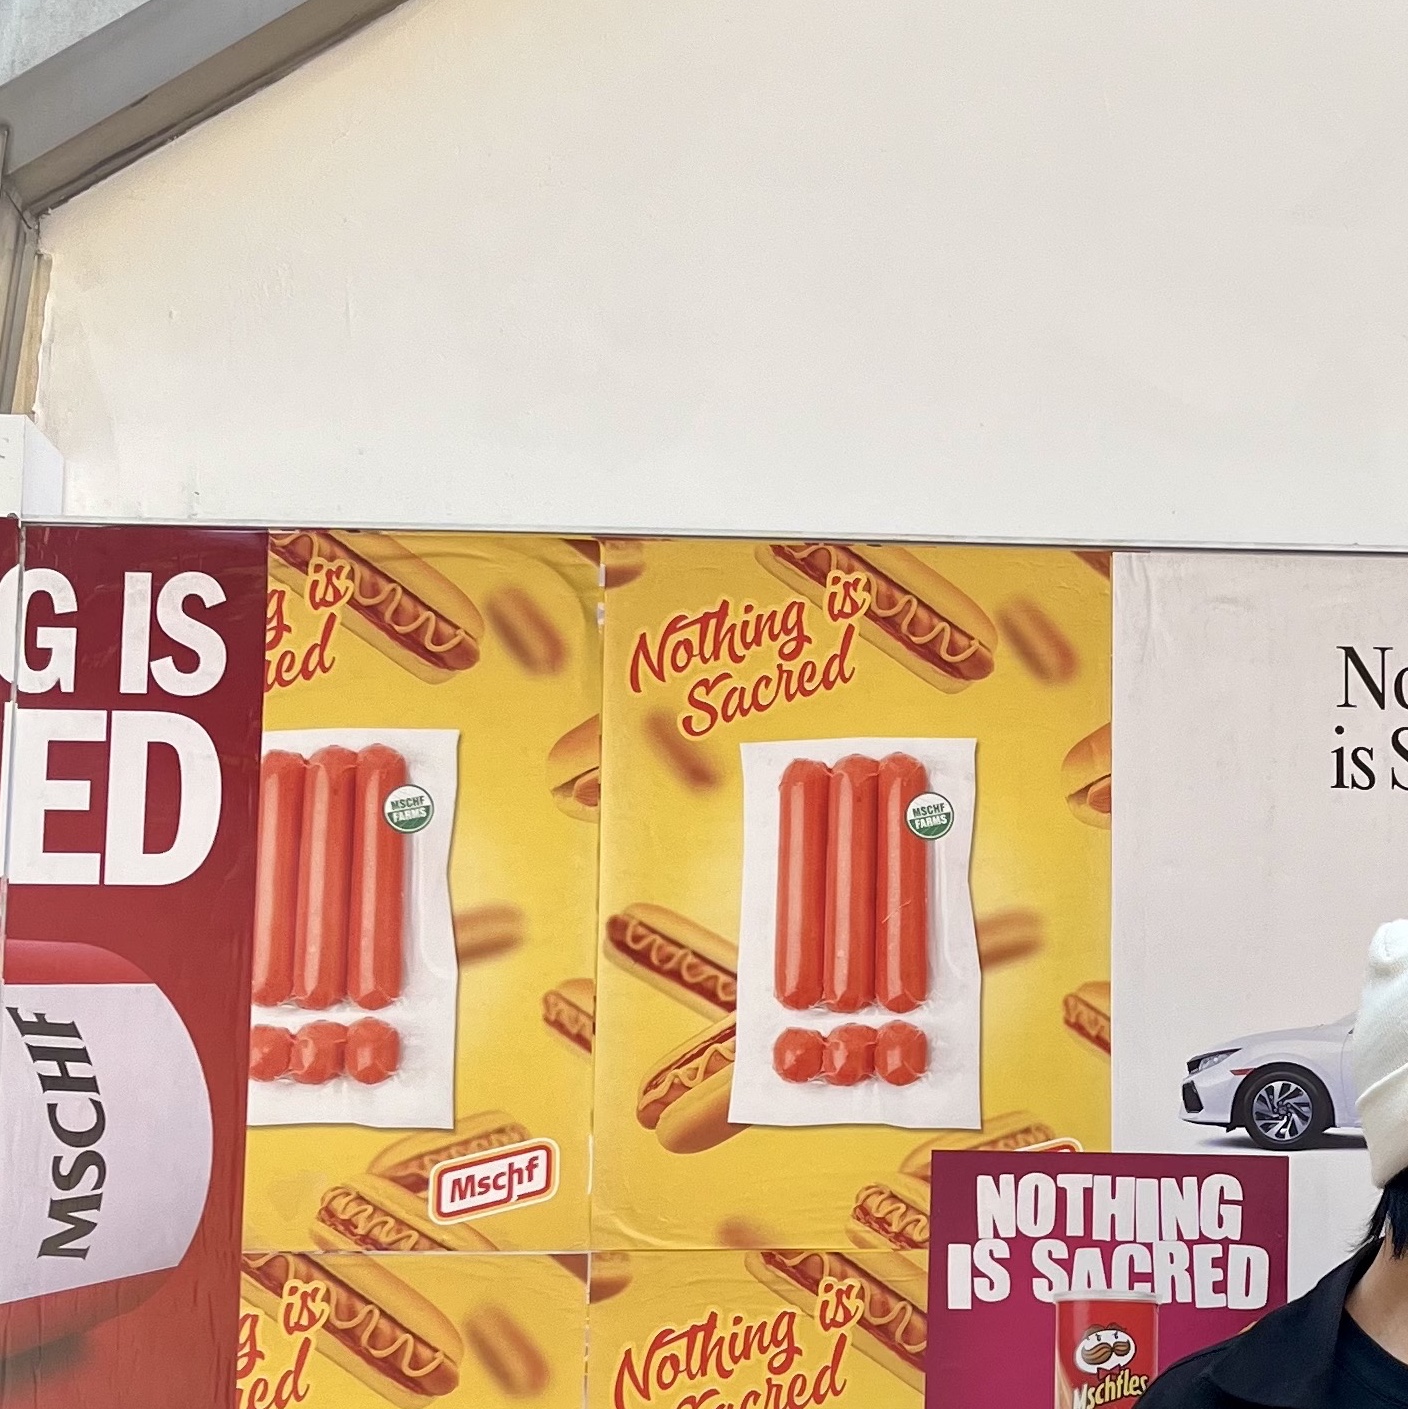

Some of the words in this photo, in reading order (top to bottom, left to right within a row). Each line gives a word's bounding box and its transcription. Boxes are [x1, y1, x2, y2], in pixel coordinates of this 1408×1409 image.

[309, 564, 350, 610] is
[119, 571, 228, 697] IS
[629, 599, 812, 693] Nothing
[827, 576, 869, 618] is
[682, 624, 856, 738] Sacred
[1330, 725, 1376, 790] is
[391, 794, 426, 810] MSCHF
[911, 802, 946, 818] MSCHF
[913, 812, 948, 829] FARMS
[6, 1006, 107, 1260] MSCHF
[450, 1157, 540, 1205] Mschf
[976, 1173, 1243, 1243] NOTHING
[947, 1239, 1011, 1310] IS
[1031, 1240, 1269, 1309] SACRED
[283, 1286, 325, 1335] is
[819, 1283, 859, 1332] is
